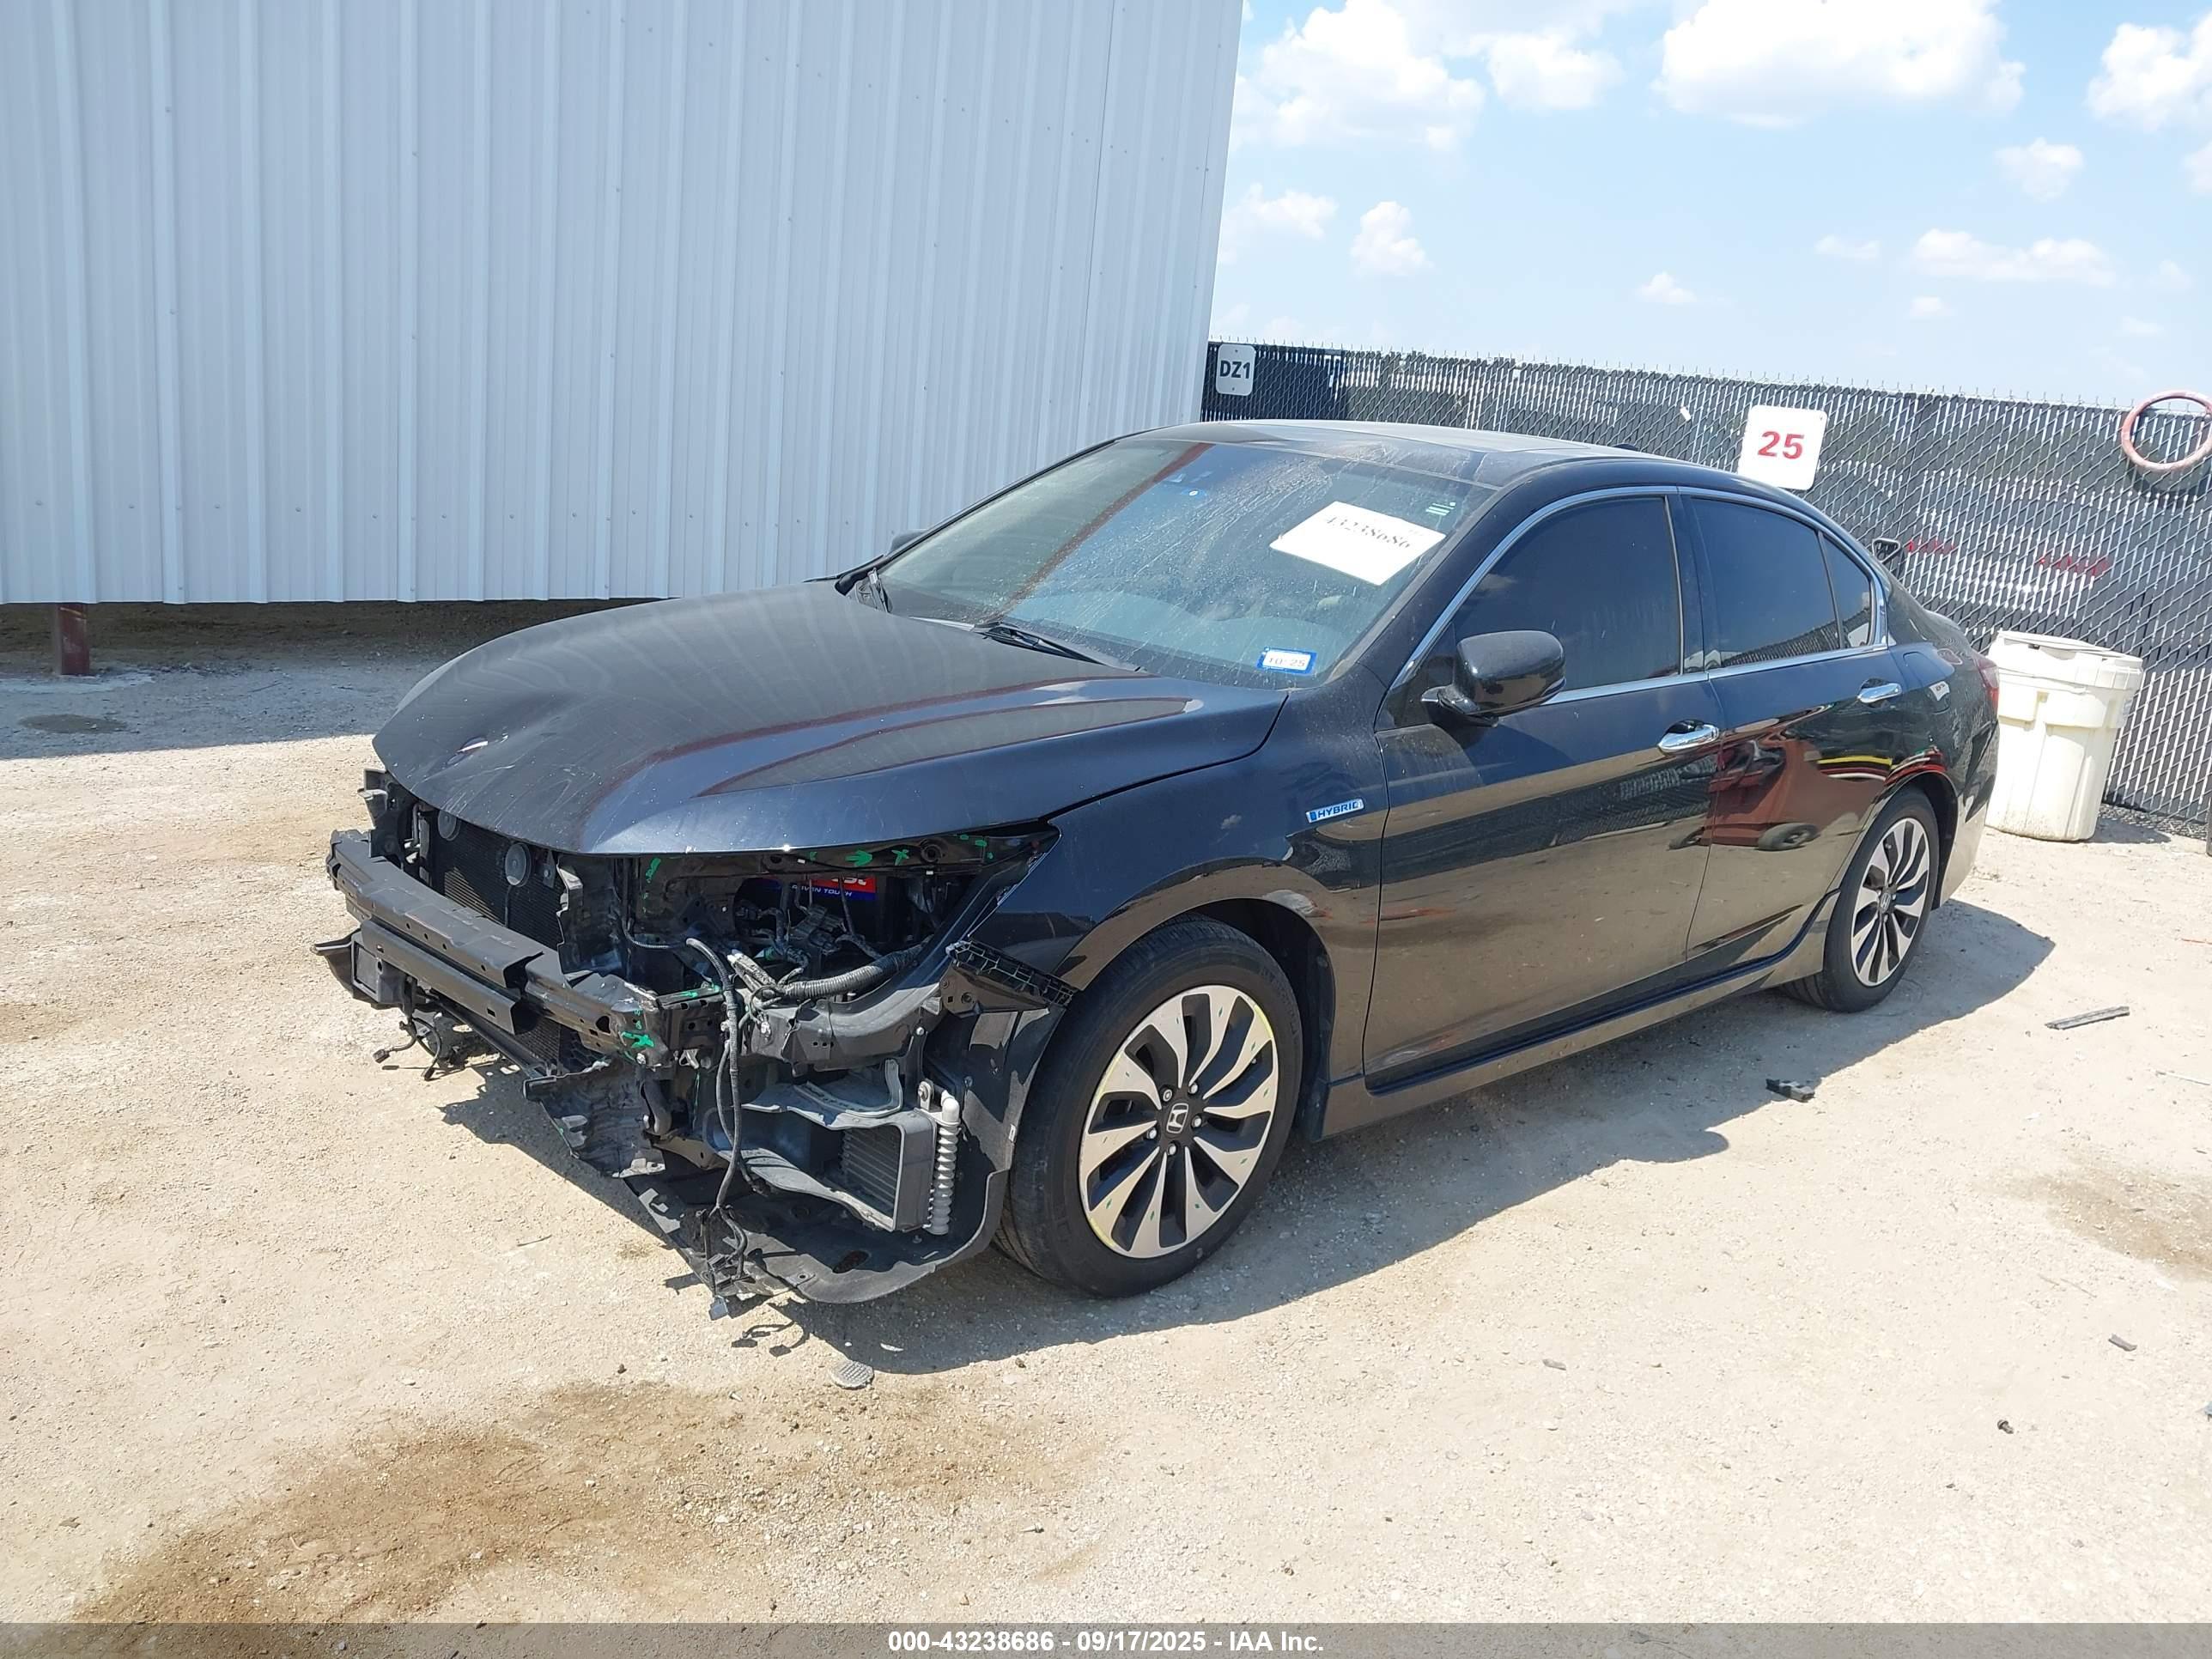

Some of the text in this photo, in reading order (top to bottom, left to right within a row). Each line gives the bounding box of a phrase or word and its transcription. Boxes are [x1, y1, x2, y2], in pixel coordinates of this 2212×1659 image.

[1219, 353, 1250, 380] DZ1
[1757, 430, 1805, 459] 25
[1317, 800, 1361, 818] HYBRID
[824, 888, 852, 896] TOUH
